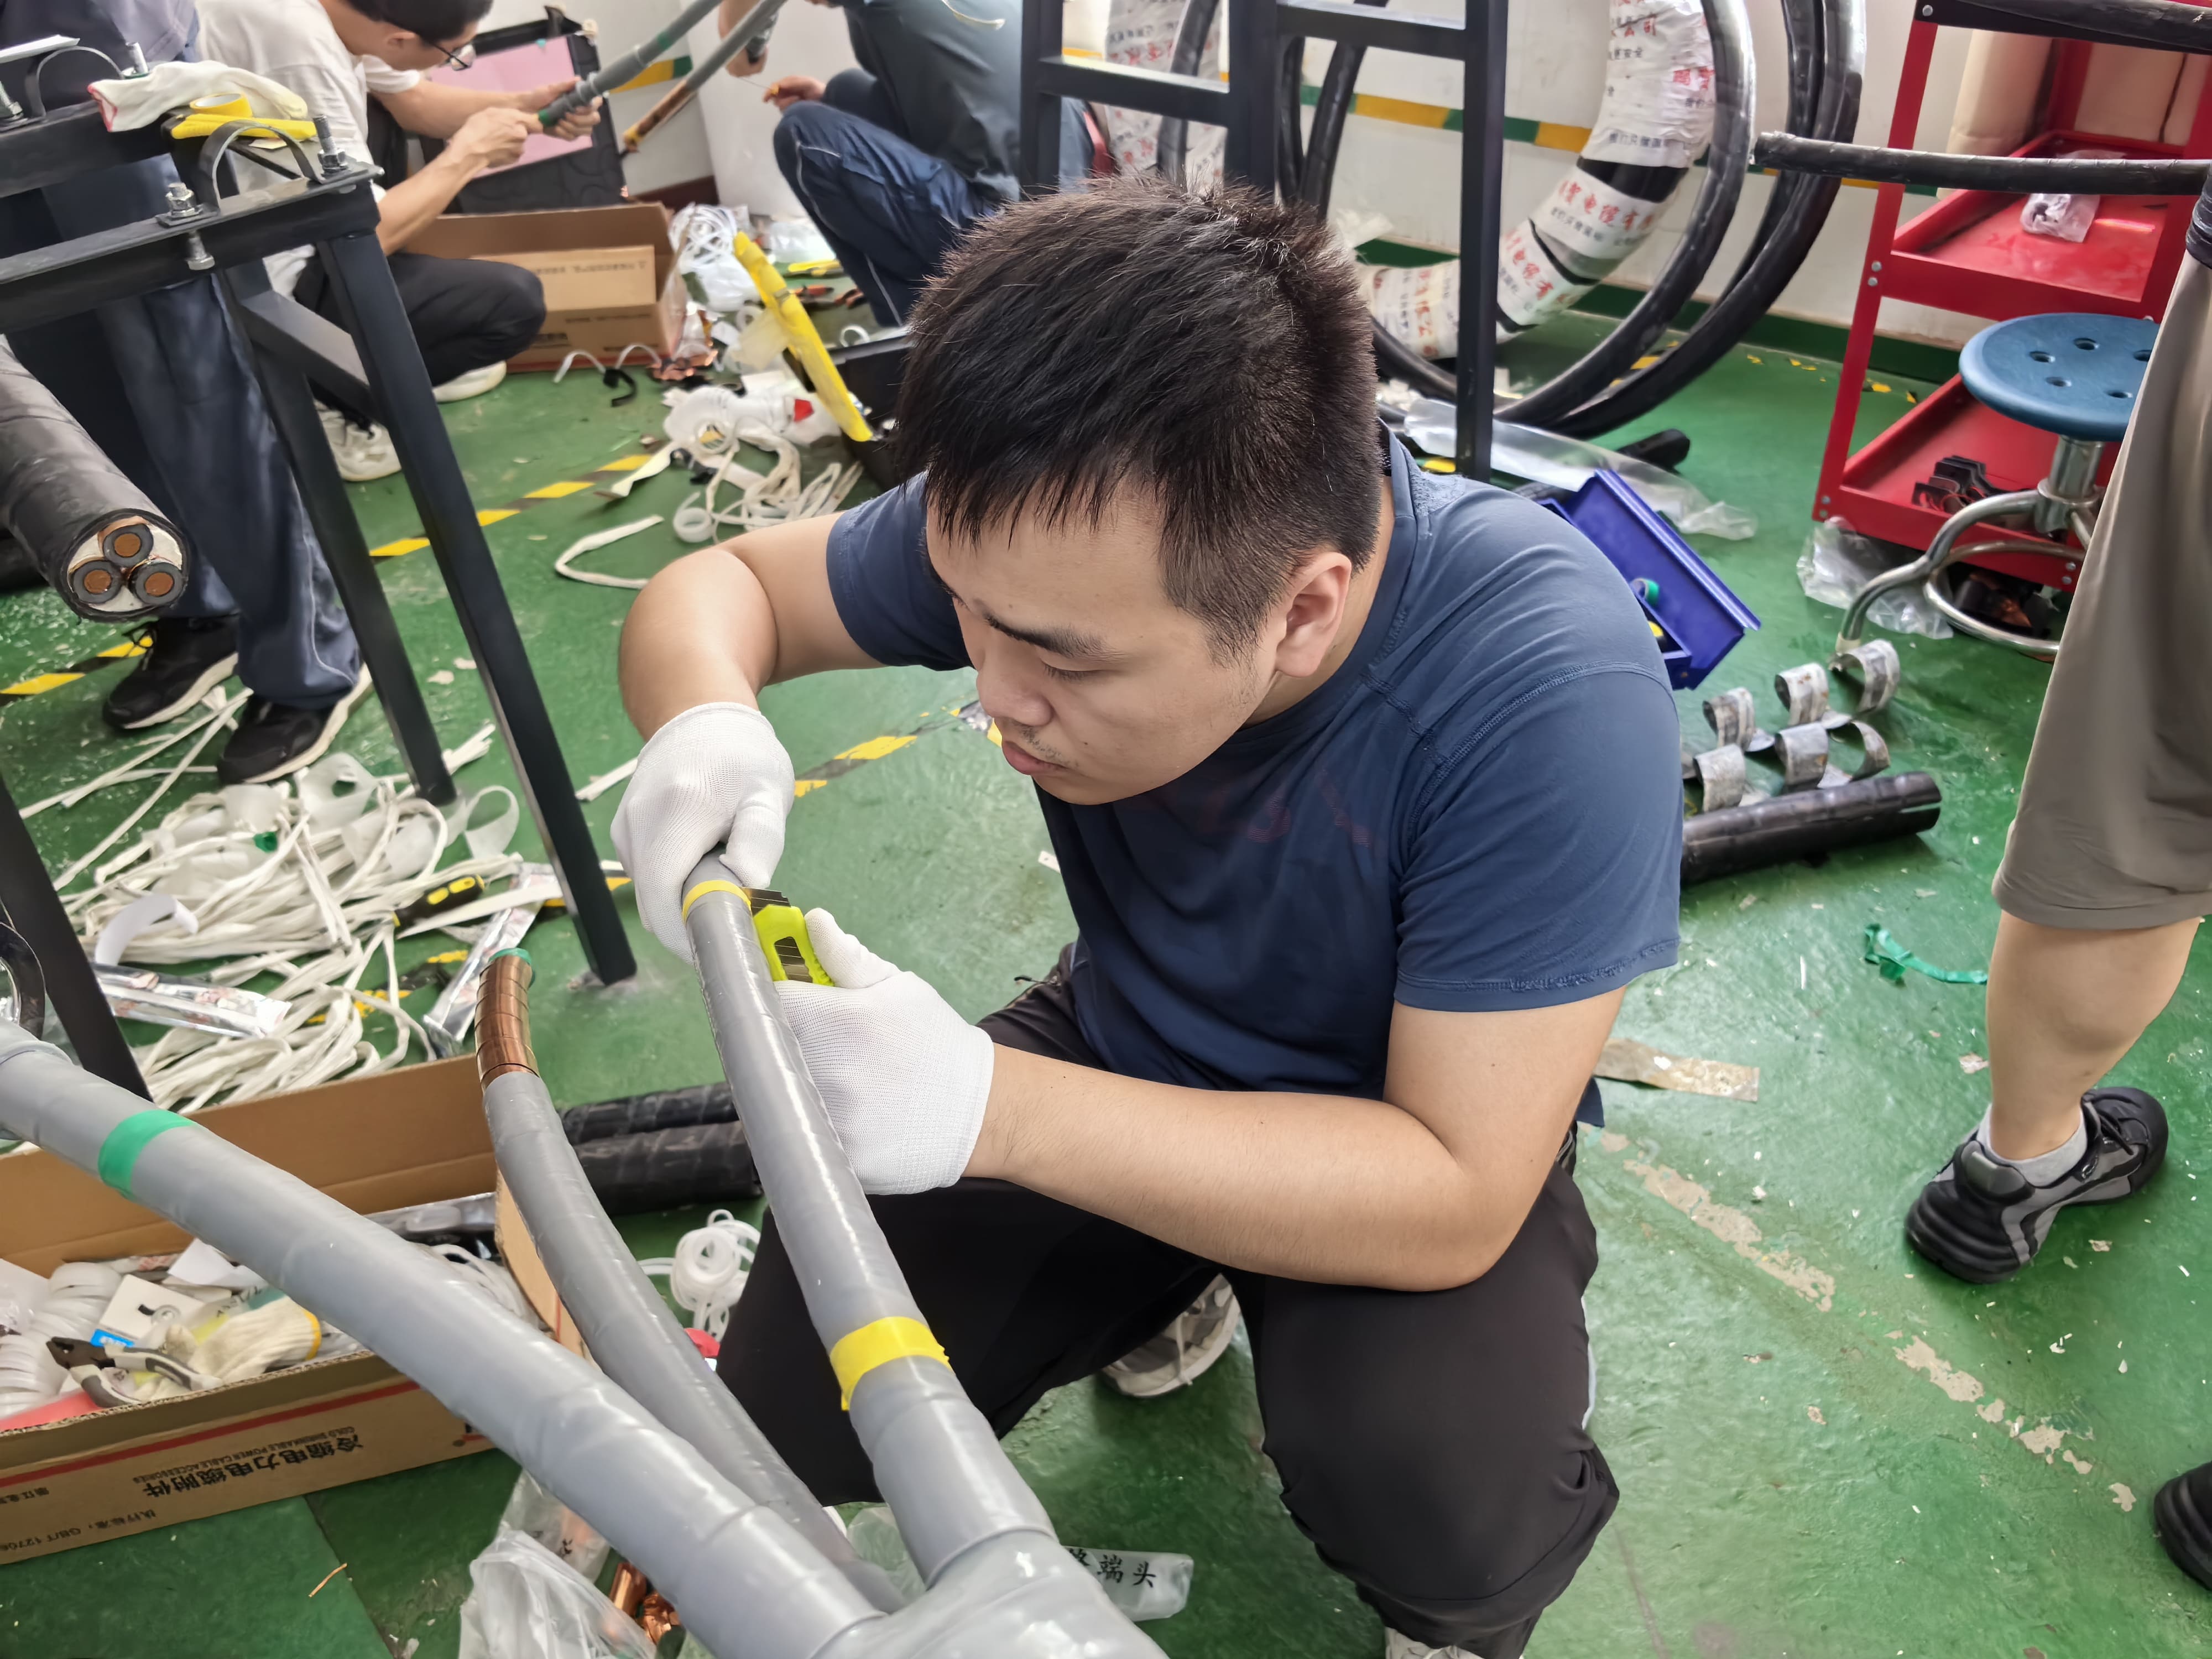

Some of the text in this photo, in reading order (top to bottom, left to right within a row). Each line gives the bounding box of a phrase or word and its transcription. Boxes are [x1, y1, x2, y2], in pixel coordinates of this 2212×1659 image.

[232, 1447, 268, 1460] POWER
[143, 1434, 363, 1498] 冷缩电力电缆附件
[199, 1455, 233, 1468] CABLE
